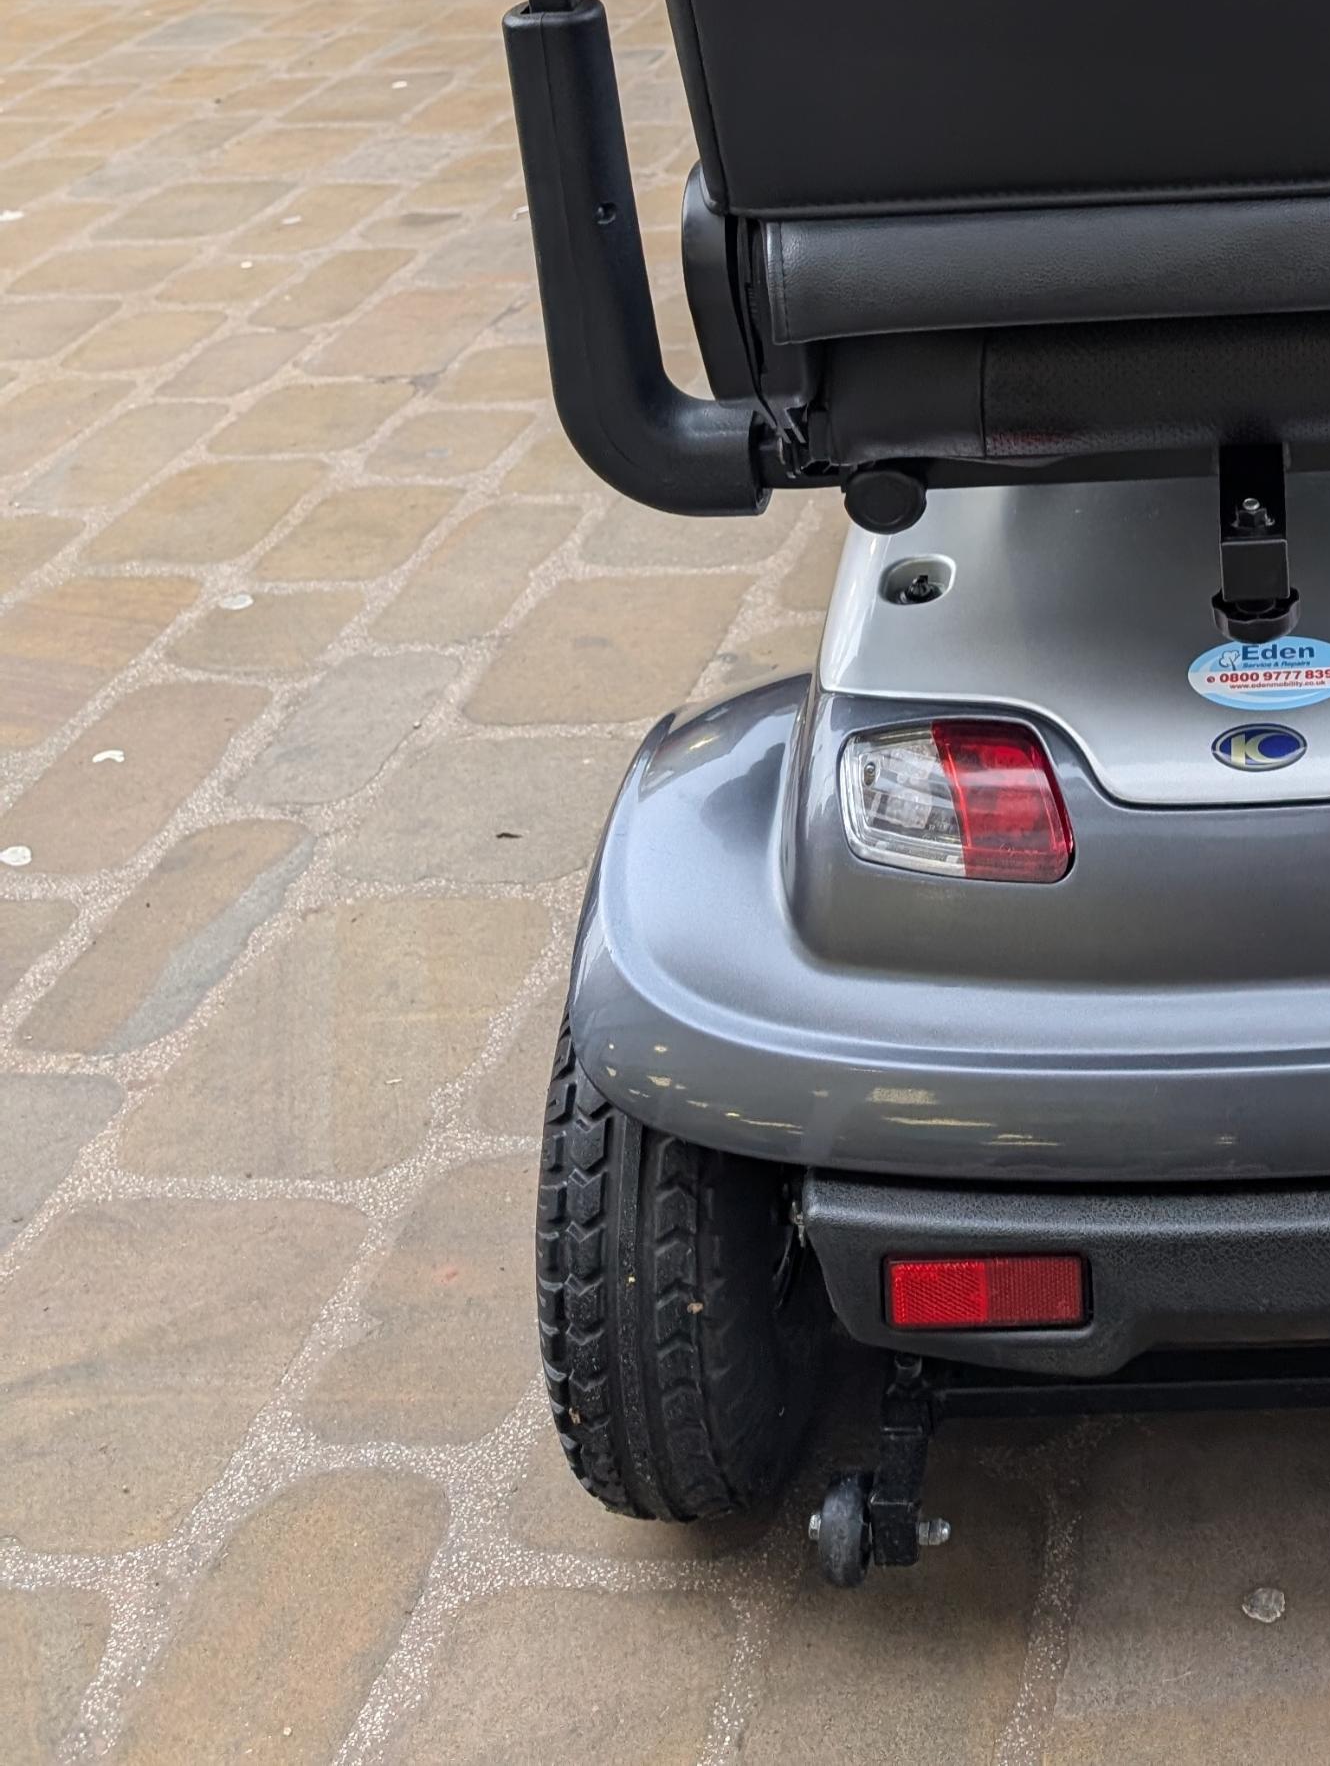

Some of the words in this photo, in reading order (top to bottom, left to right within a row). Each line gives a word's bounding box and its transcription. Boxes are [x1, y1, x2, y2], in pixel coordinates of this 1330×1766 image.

[1242, 644, 1315, 660] Eden
[1281, 660, 1310, 668] Repairs
[1219, 672, 1260, 683] 0800
[1263, 670, 1302, 681] 9777
[1229, 680, 1326, 689] www.edenmobility.co.uk
